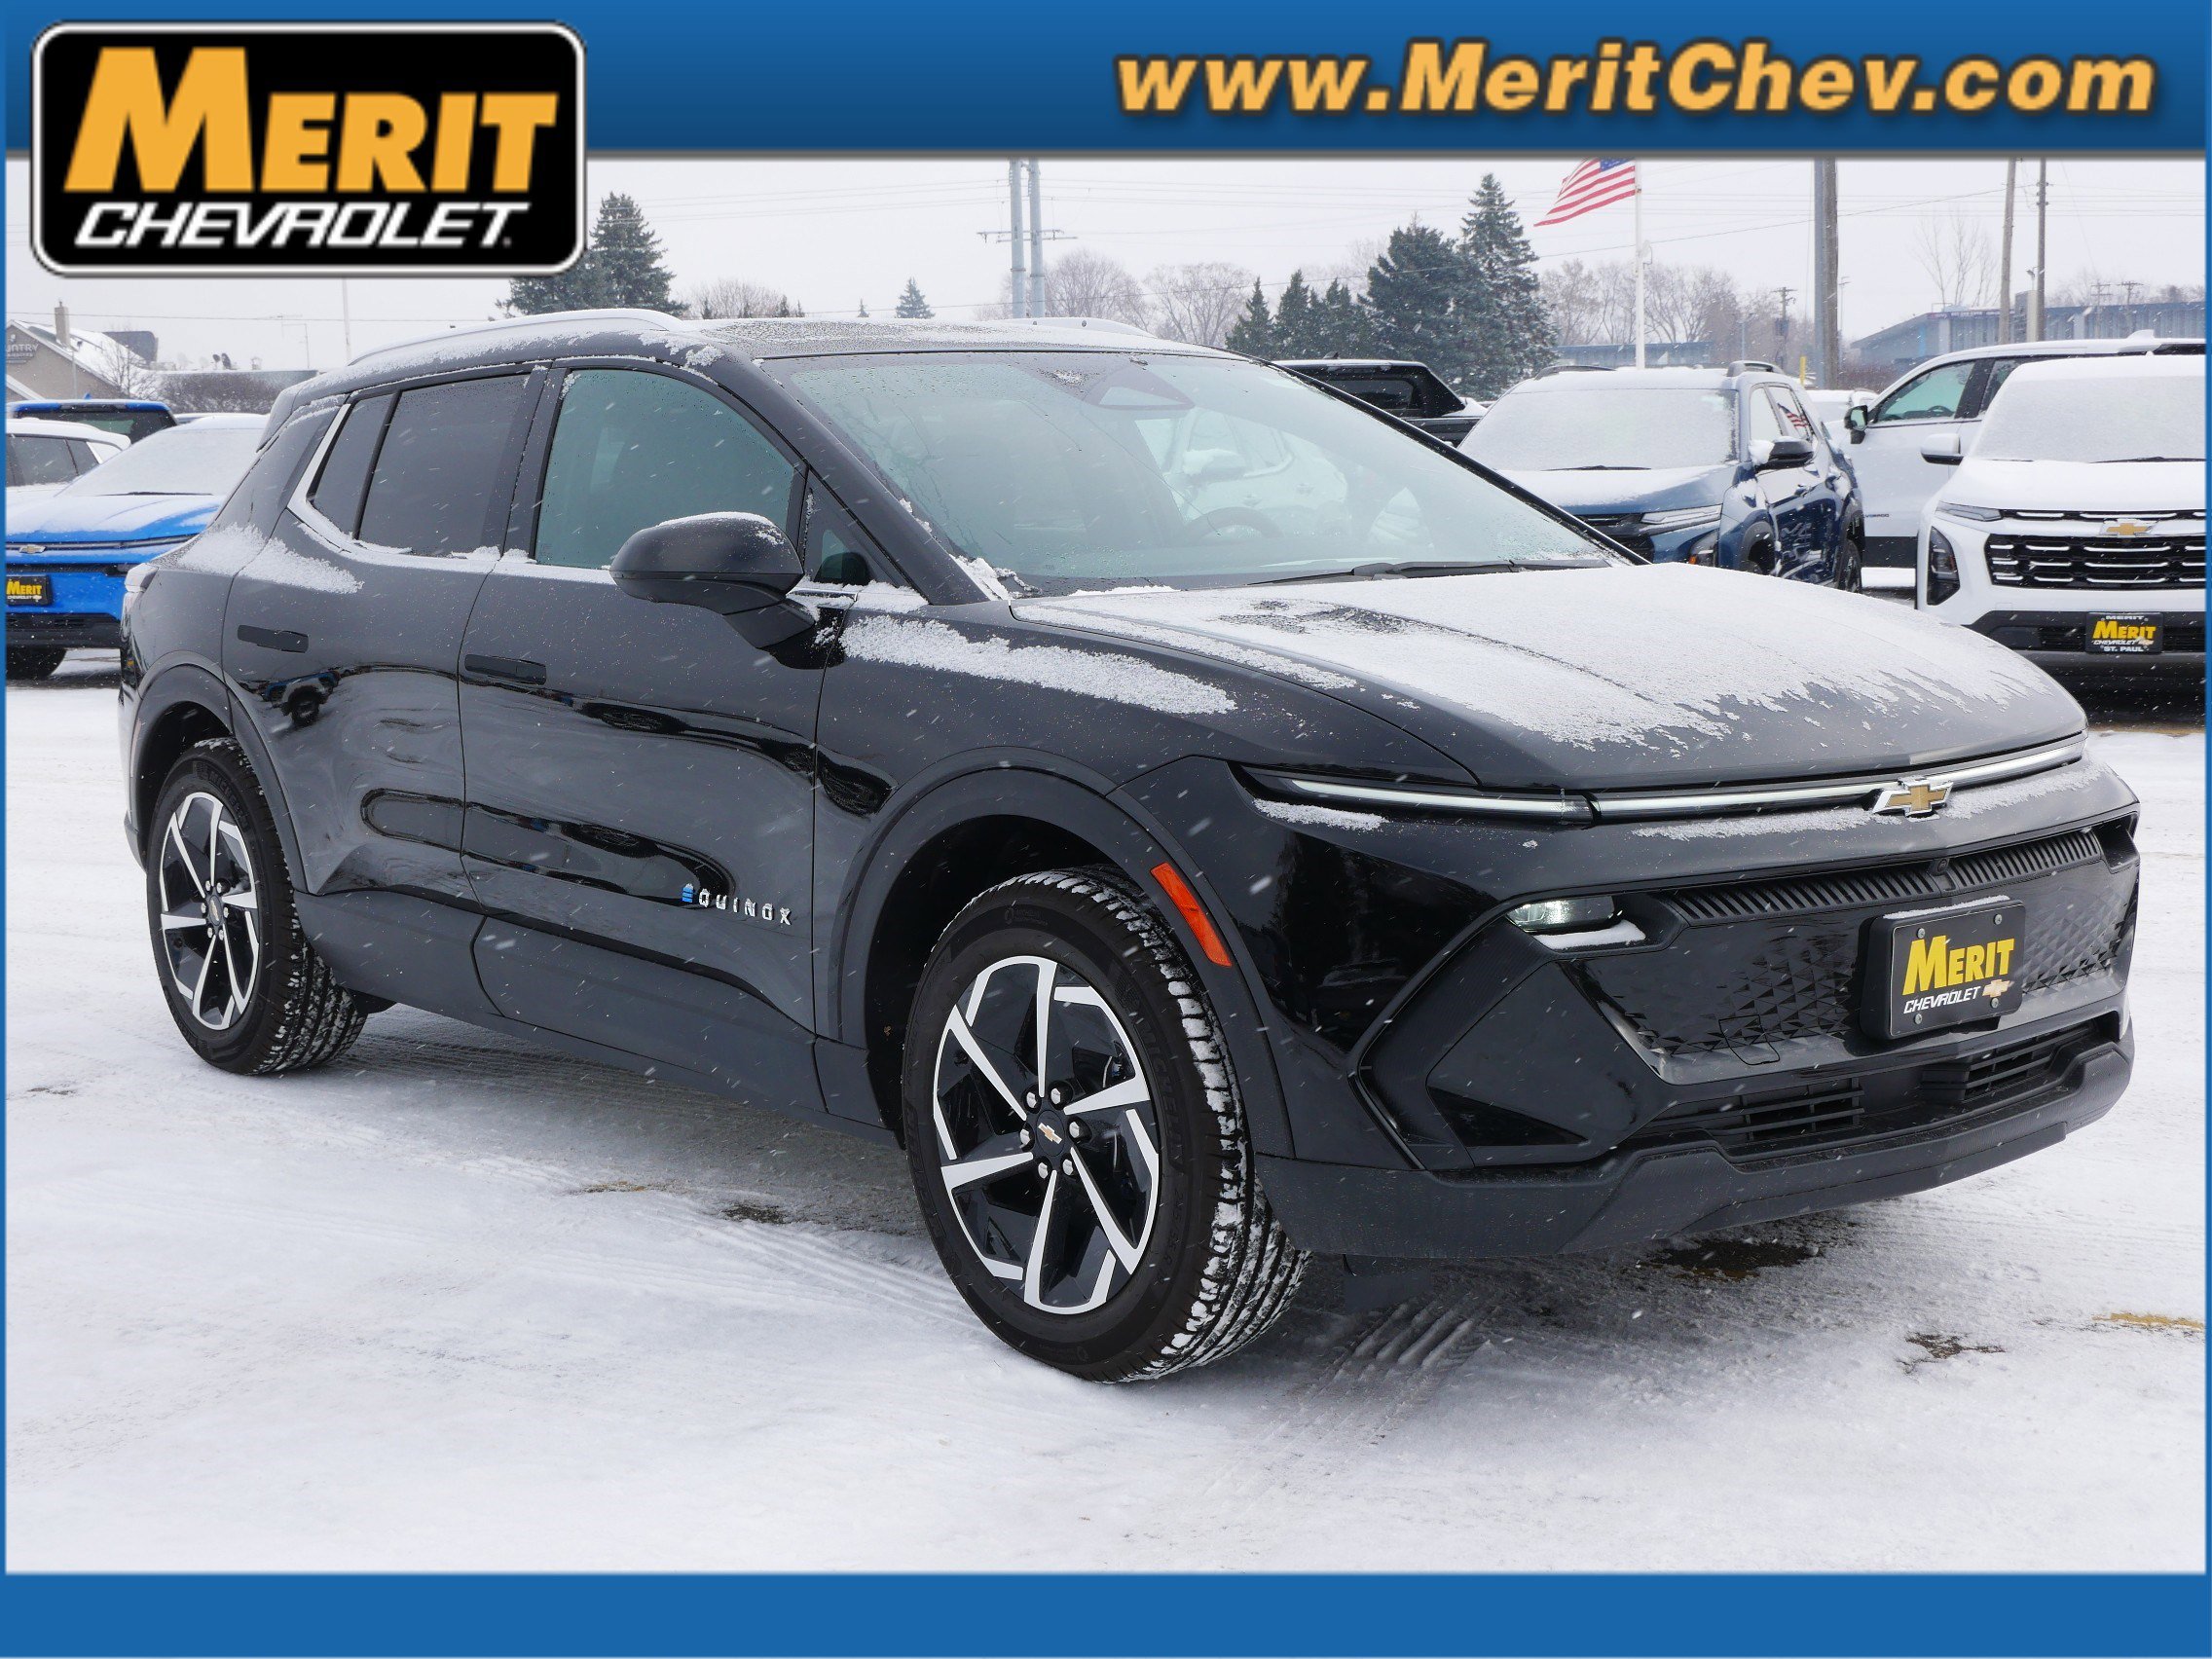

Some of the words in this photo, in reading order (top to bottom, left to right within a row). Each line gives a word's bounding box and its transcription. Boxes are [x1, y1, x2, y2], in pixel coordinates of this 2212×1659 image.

[7, 580, 43, 595] MERIT
[2092, 620, 2157, 639] MERIT
[682, 883, 792, 926] EQUINOX
[1901, 935, 2015, 996] MERIT
[1903, 986, 1980, 1014] CHEVROLET
